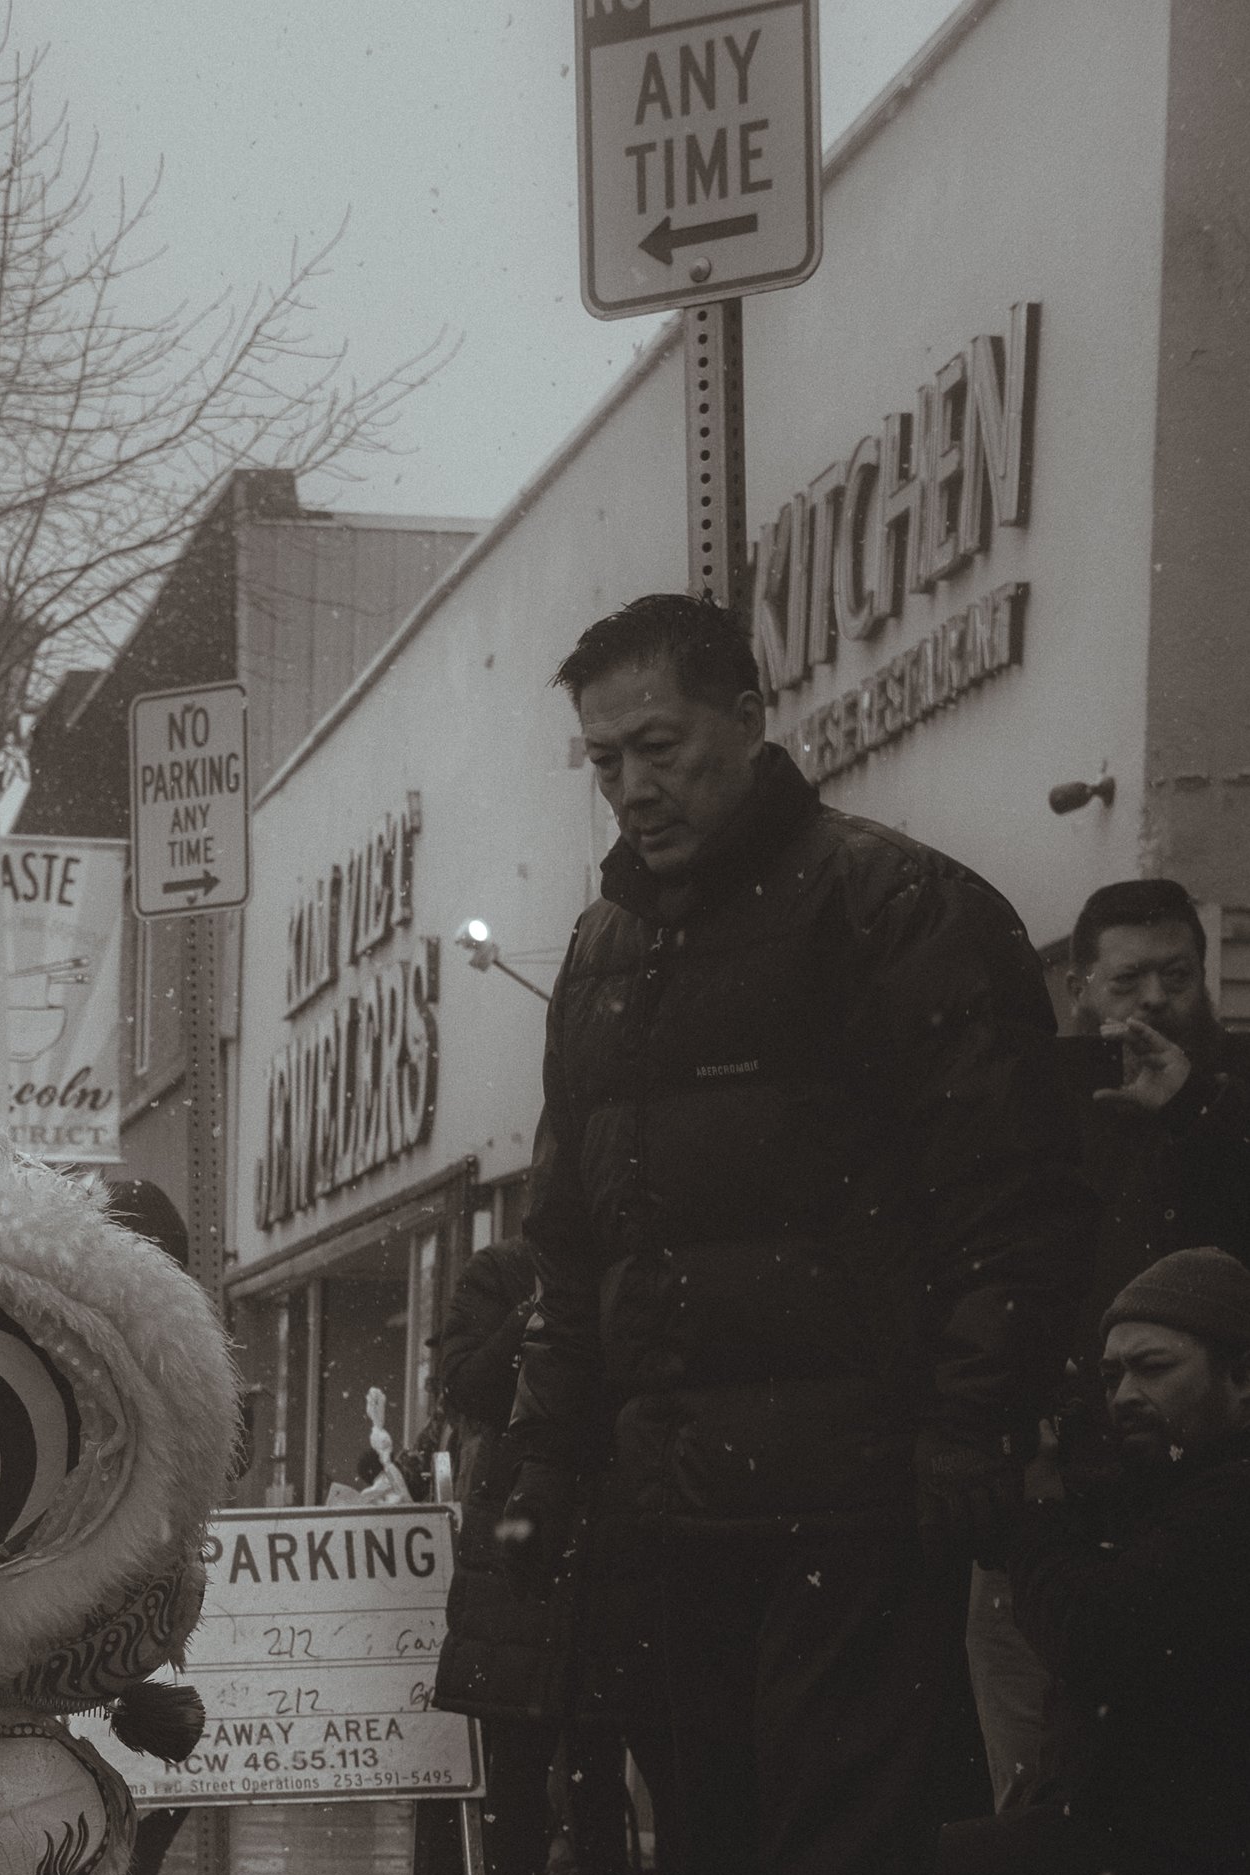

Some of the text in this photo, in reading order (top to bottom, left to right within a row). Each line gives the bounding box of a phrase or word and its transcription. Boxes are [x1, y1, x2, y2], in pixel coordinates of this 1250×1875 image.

[635, 28, 762, 125] ANY
[625, 118, 773, 215] TIME
[753, 301, 1042, 708] KITCHEN
[168, 706, 210, 751] NO
[141, 752, 240, 805] PARKING
[171, 803, 211, 835] ANY
[167, 836, 215, 868] TIME
[2, 852, 80, 907] ASTE
[256, 937, 440, 1232] JEWELERS
[696, 1060, 760, 1078] ABERCROMBIE
[11, 1125, 109, 1146] TRICT
[202, 1527, 436, 1584] PARKING
[201, 1717, 404, 1747] -AWAY AREA
[165, 1747, 380, 1775] RCW 46.55.113
[190, 1778, 236, 1793] Street
[242, 1775, 320, 1794] Operations
[333, 1769, 453, 1788] 253-591-5495
